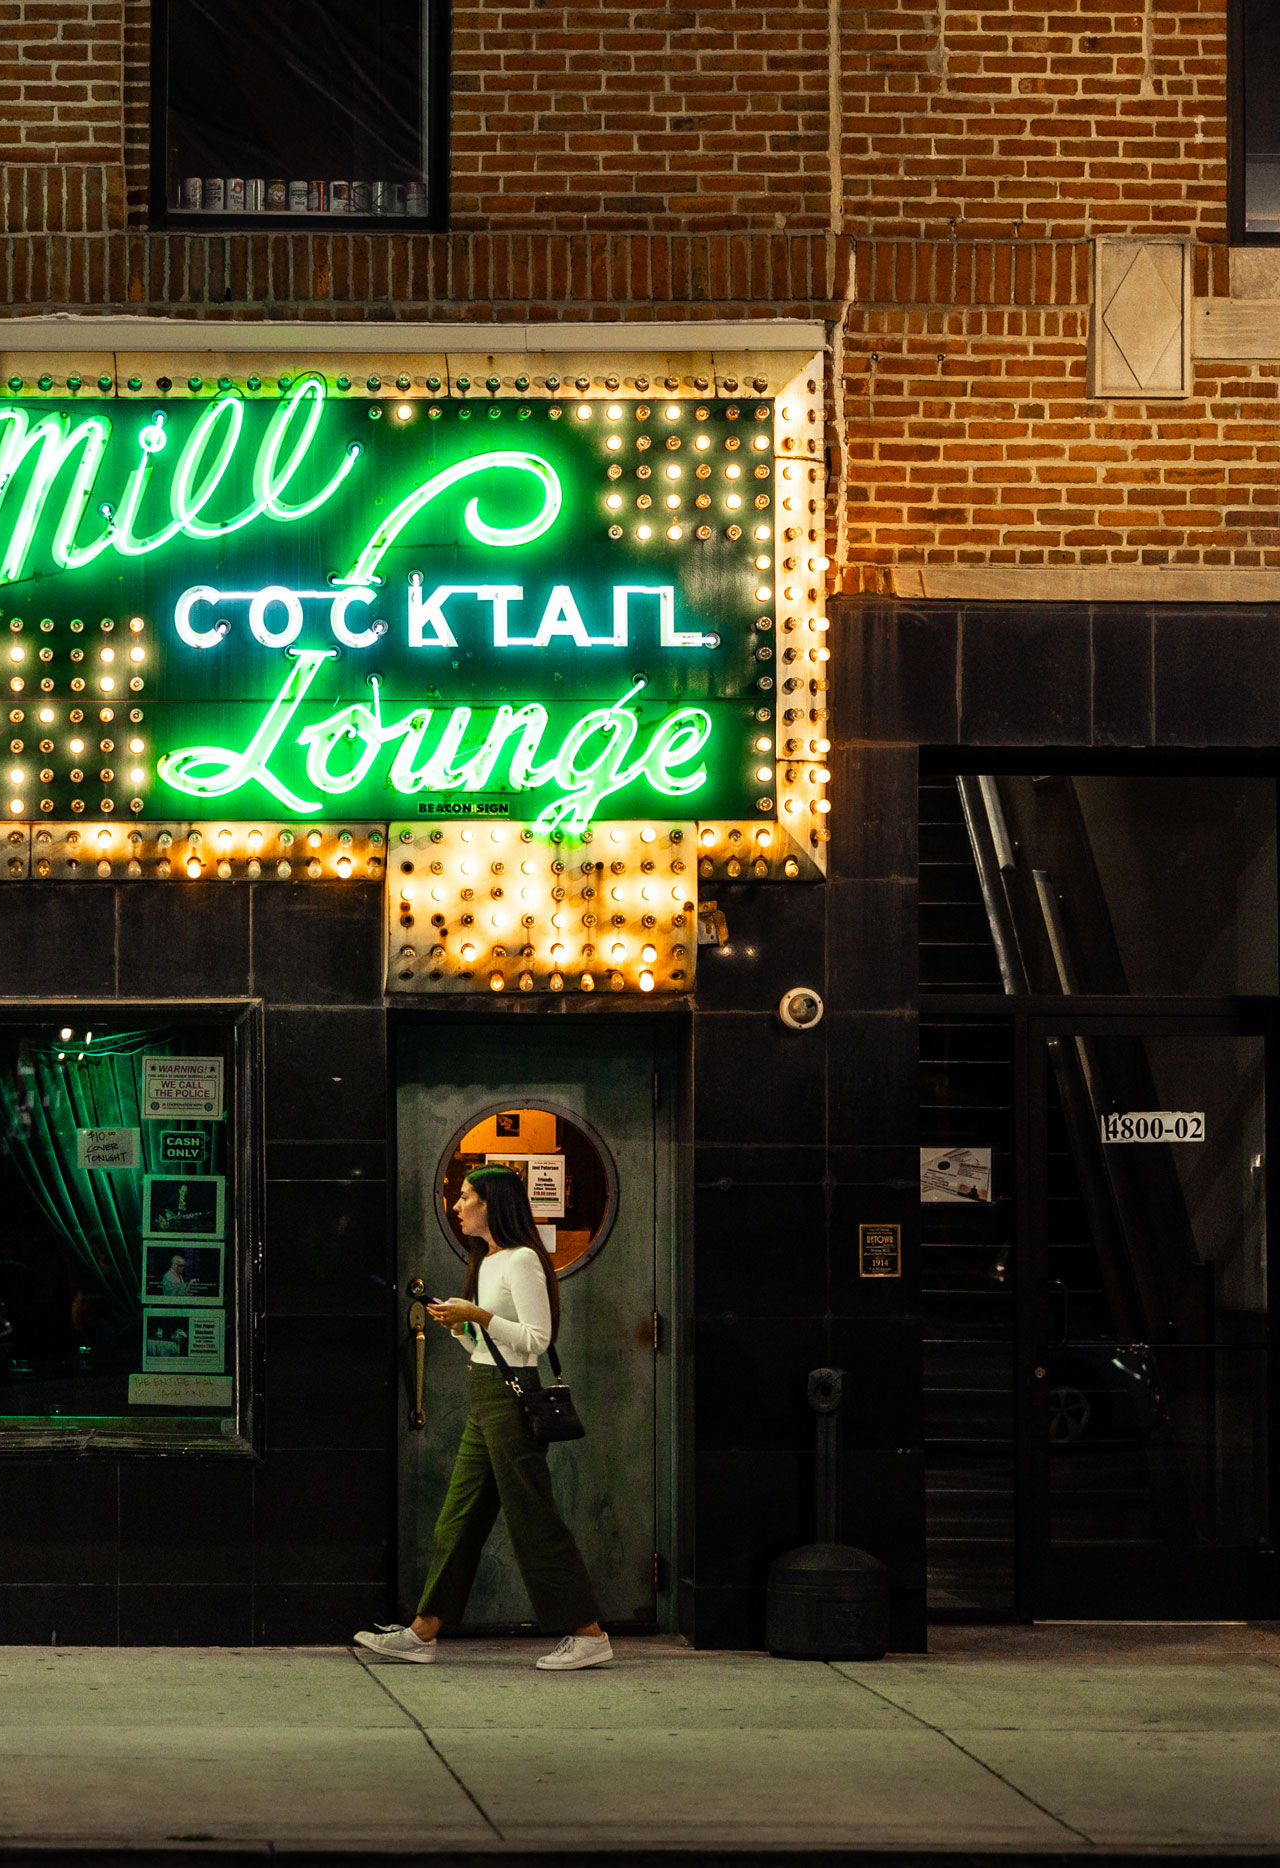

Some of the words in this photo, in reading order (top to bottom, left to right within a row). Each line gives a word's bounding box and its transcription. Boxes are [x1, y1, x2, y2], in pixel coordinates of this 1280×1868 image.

[174, 585, 718, 648] COCKTAIL
[157, 649, 713, 833] Lounge
[418, 803, 472, 814] BEACON
[477, 803, 509, 814] SIGN
[158, 1065, 208, 1074] WARNING!
[161, 1081, 176, 1089] WE
[179, 1081, 204, 1089] CALL
[154, 1089, 173, 1097] THE
[176, 1089, 211, 1098] POLICE
[1107, 1117, 1203, 1139] 4800-02
[166, 1137, 200, 1147] CASH
[86, 1143, 119, 1153] COVER
[166, 1148, 200, 1158] ONLY
[84, 1152, 128, 1163] TONIGHT
